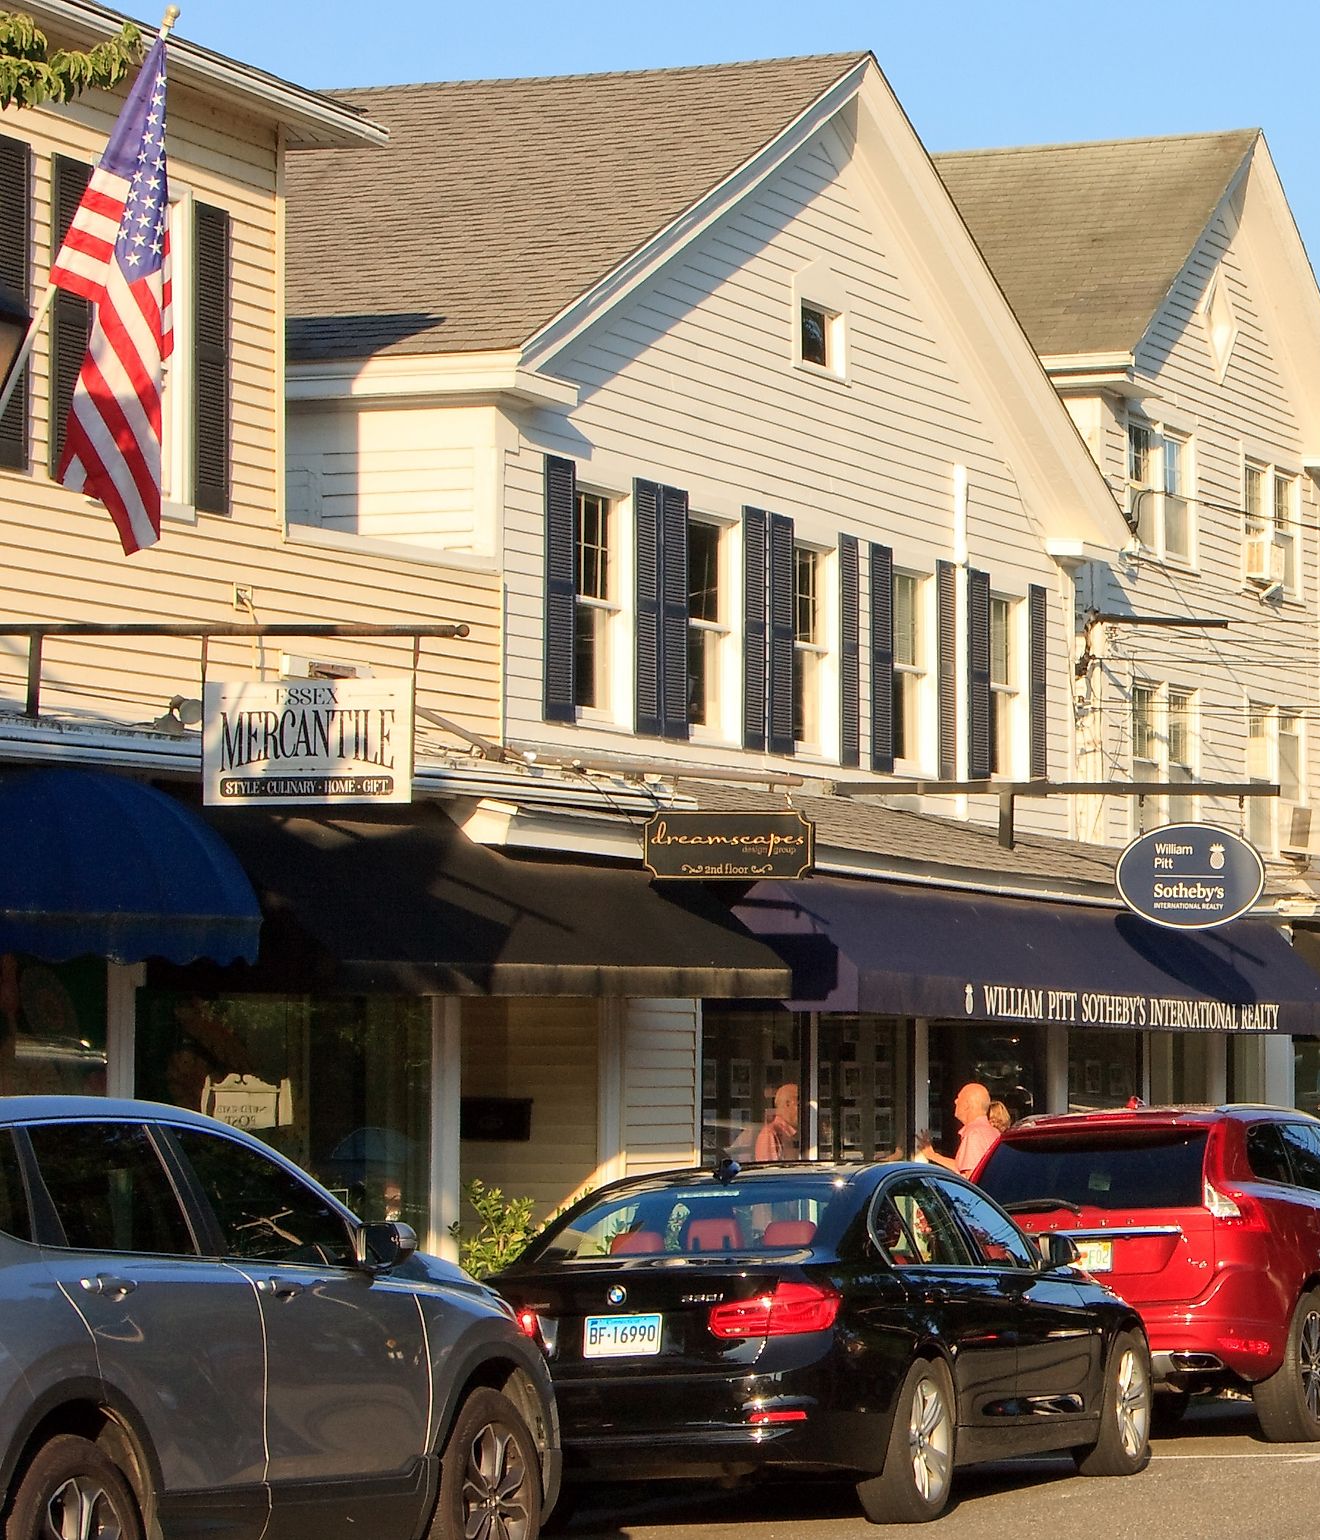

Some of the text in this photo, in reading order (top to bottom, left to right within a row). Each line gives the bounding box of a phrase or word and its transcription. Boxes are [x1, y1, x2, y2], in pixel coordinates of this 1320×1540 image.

[275, 687, 339, 706] ESSEX
[219, 708, 395, 773] MERCANTILE
[225, 778, 389, 795] STYLE CULINARY HOME GIFT
[650, 821, 804, 857] dreamscapes
[773, 846, 797, 856] group
[1155, 843, 1193, 855] William
[704, 863, 749, 875] 2nd floor
[1154, 857, 1174, 869] Pitt
[1153, 882, 1225, 902] Sotheby's
[1153, 902, 1224, 911] INTERNATIONAL REALTY
[983, 985, 1280, 1031] WILLIAM PITT SOTHEBY'S INTERNATIONAL REALTY
